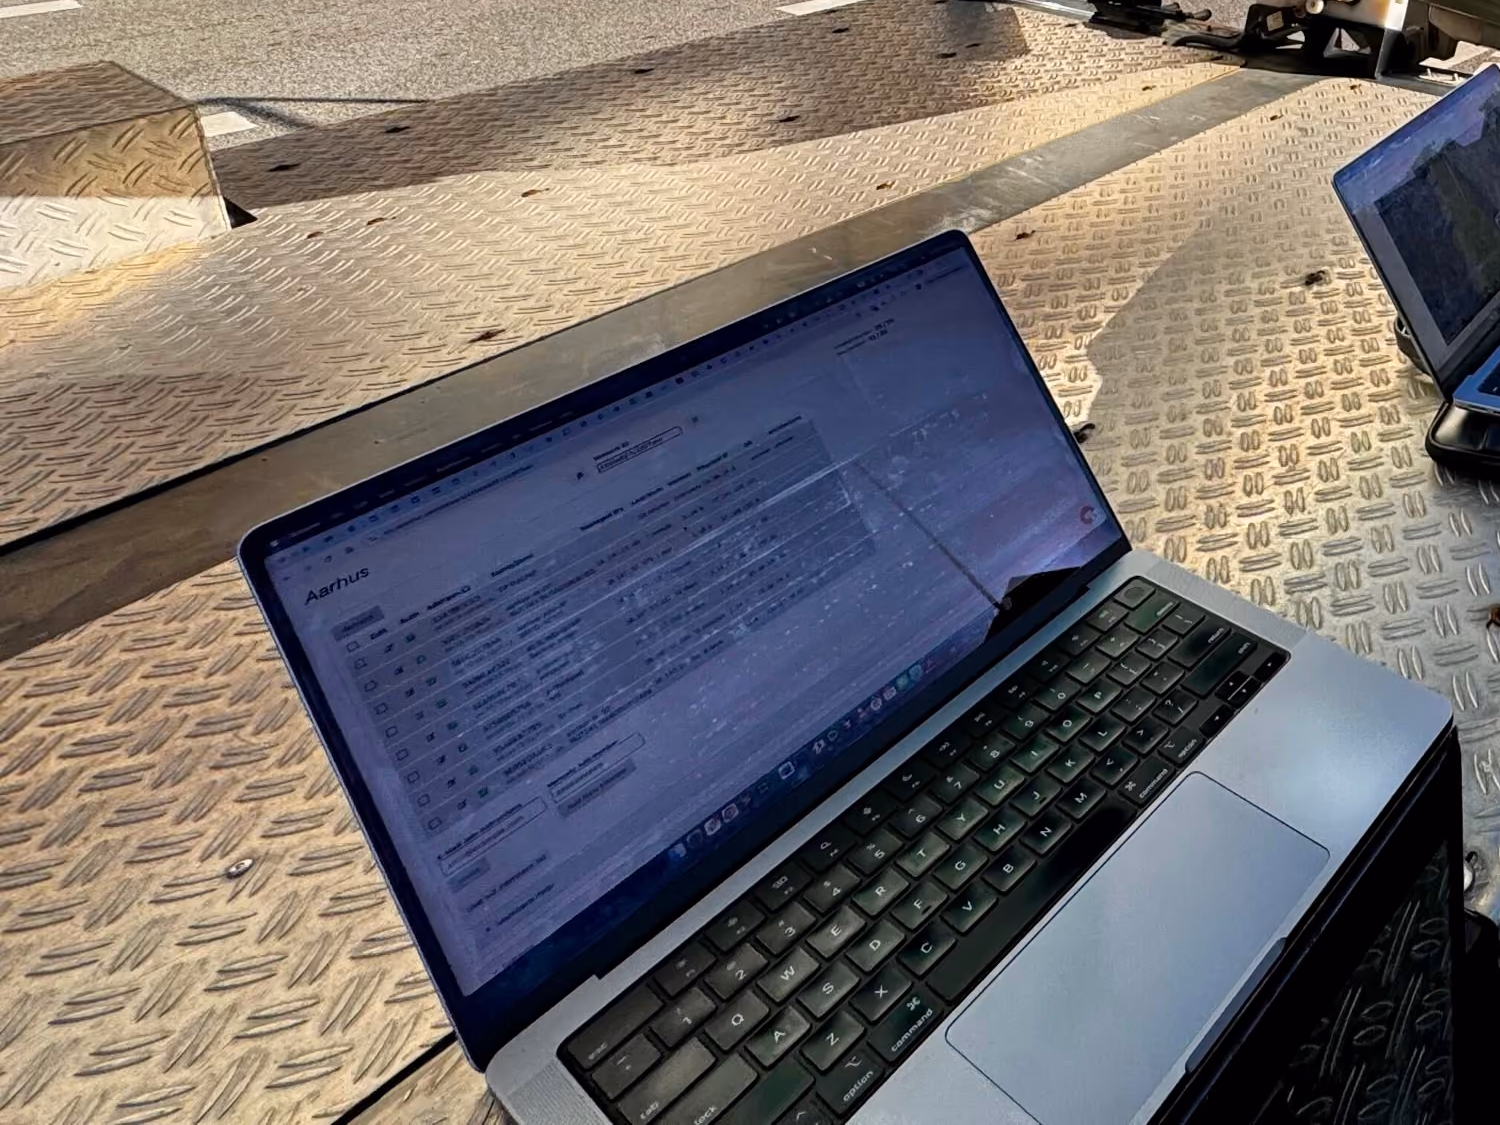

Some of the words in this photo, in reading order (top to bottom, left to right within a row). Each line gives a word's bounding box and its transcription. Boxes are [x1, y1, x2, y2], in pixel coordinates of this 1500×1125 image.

[304, 566, 370, 606] Aarhus
[1062, 719, 1073, 728] O
[1097, 729, 1108, 738] L
[1064, 759, 1077, 768] K
[954, 780, 964, 790] 7
[993, 779, 1006, 790] U
[1032, 791, 1041, 800] J
[1074, 792, 1088, 804] M
[915, 813, 927, 824] 6
[956, 812, 968, 823] Y
[992, 823, 1006, 835] H
[1039, 826, 1053, 838] N
[873, 849, 886, 859] 5
[916, 848, 928, 859] T
[954, 860, 967, 871] G
[1002, 862, 1015, 874] B
[831, 886, 842, 897] 4
[874, 886, 887, 897] R
[913, 898, 924, 910] F
[961, 900, 974, 912] V
[783, 926, 797, 938] 3
[830, 924, 843, 937] E
[869, 939, 882, 951] D
[920, 942, 934, 954] C
[735, 969, 748, 981] 2
[780, 965, 796, 982] W
[821, 981, 836, 996] S
[873, 984, 889, 998] X
[731, 1012, 746, 1027] Q
[890, 1007, 934, 1053] command
[773, 1030, 787, 1044] A
[825, 1031, 841, 1047] Z
[842, 1069, 875, 1103] option
